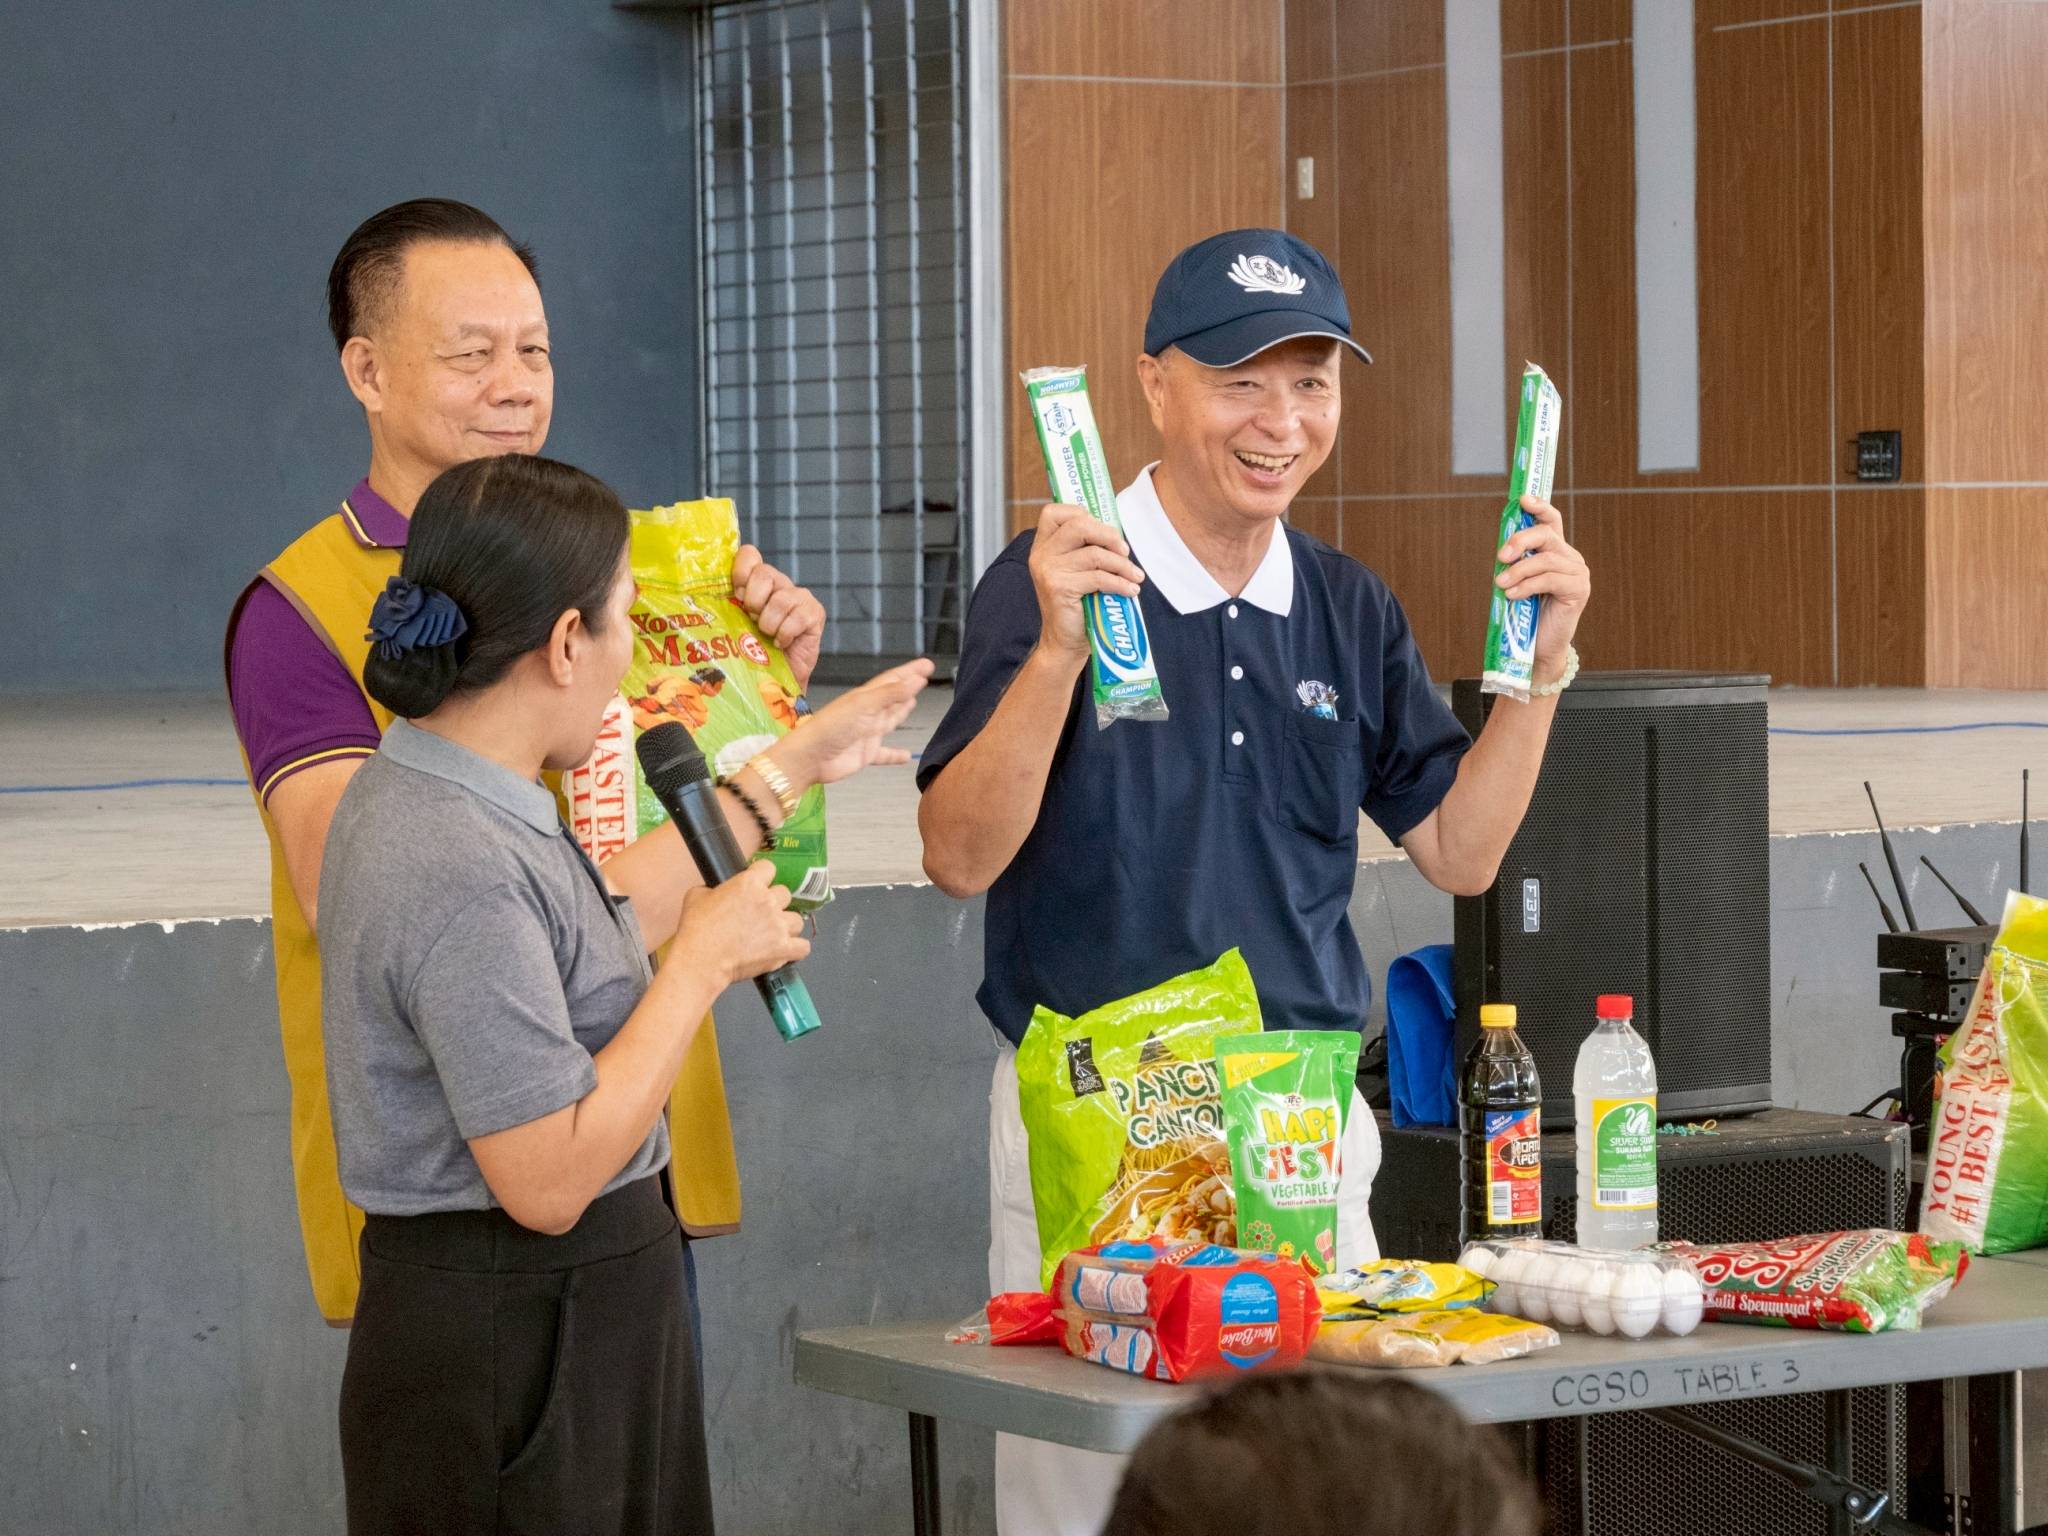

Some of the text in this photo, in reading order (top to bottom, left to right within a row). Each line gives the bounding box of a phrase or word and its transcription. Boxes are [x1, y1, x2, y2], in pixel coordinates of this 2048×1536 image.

[1052, 401, 1067, 438] X-STAIN
[1062, 446, 1079, 486] POWER
[1534, 440, 1545, 475] POWER
[1085, 479, 1101, 519] ALAMANSI
[1102, 594, 1139, 662] CHAMP
[639, 633, 740, 667] Mast
[1110, 682, 1152, 697] CHAMPION
[1526, 884, 1538, 926] FBT
[1609, 1136, 1638, 1147] SILVER
[1927, 1101, 1969, 1213] YOUNG
[1958, 1100, 1998, 1183] BEST
[1271, 1181, 1329, 1199] VEGETABLE
[1949, 1192, 1980, 1225] #1
[1795, 1236, 1859, 1290] Spaghetti
[1552, 1359, 1801, 1408] CGSO TABLE 3
